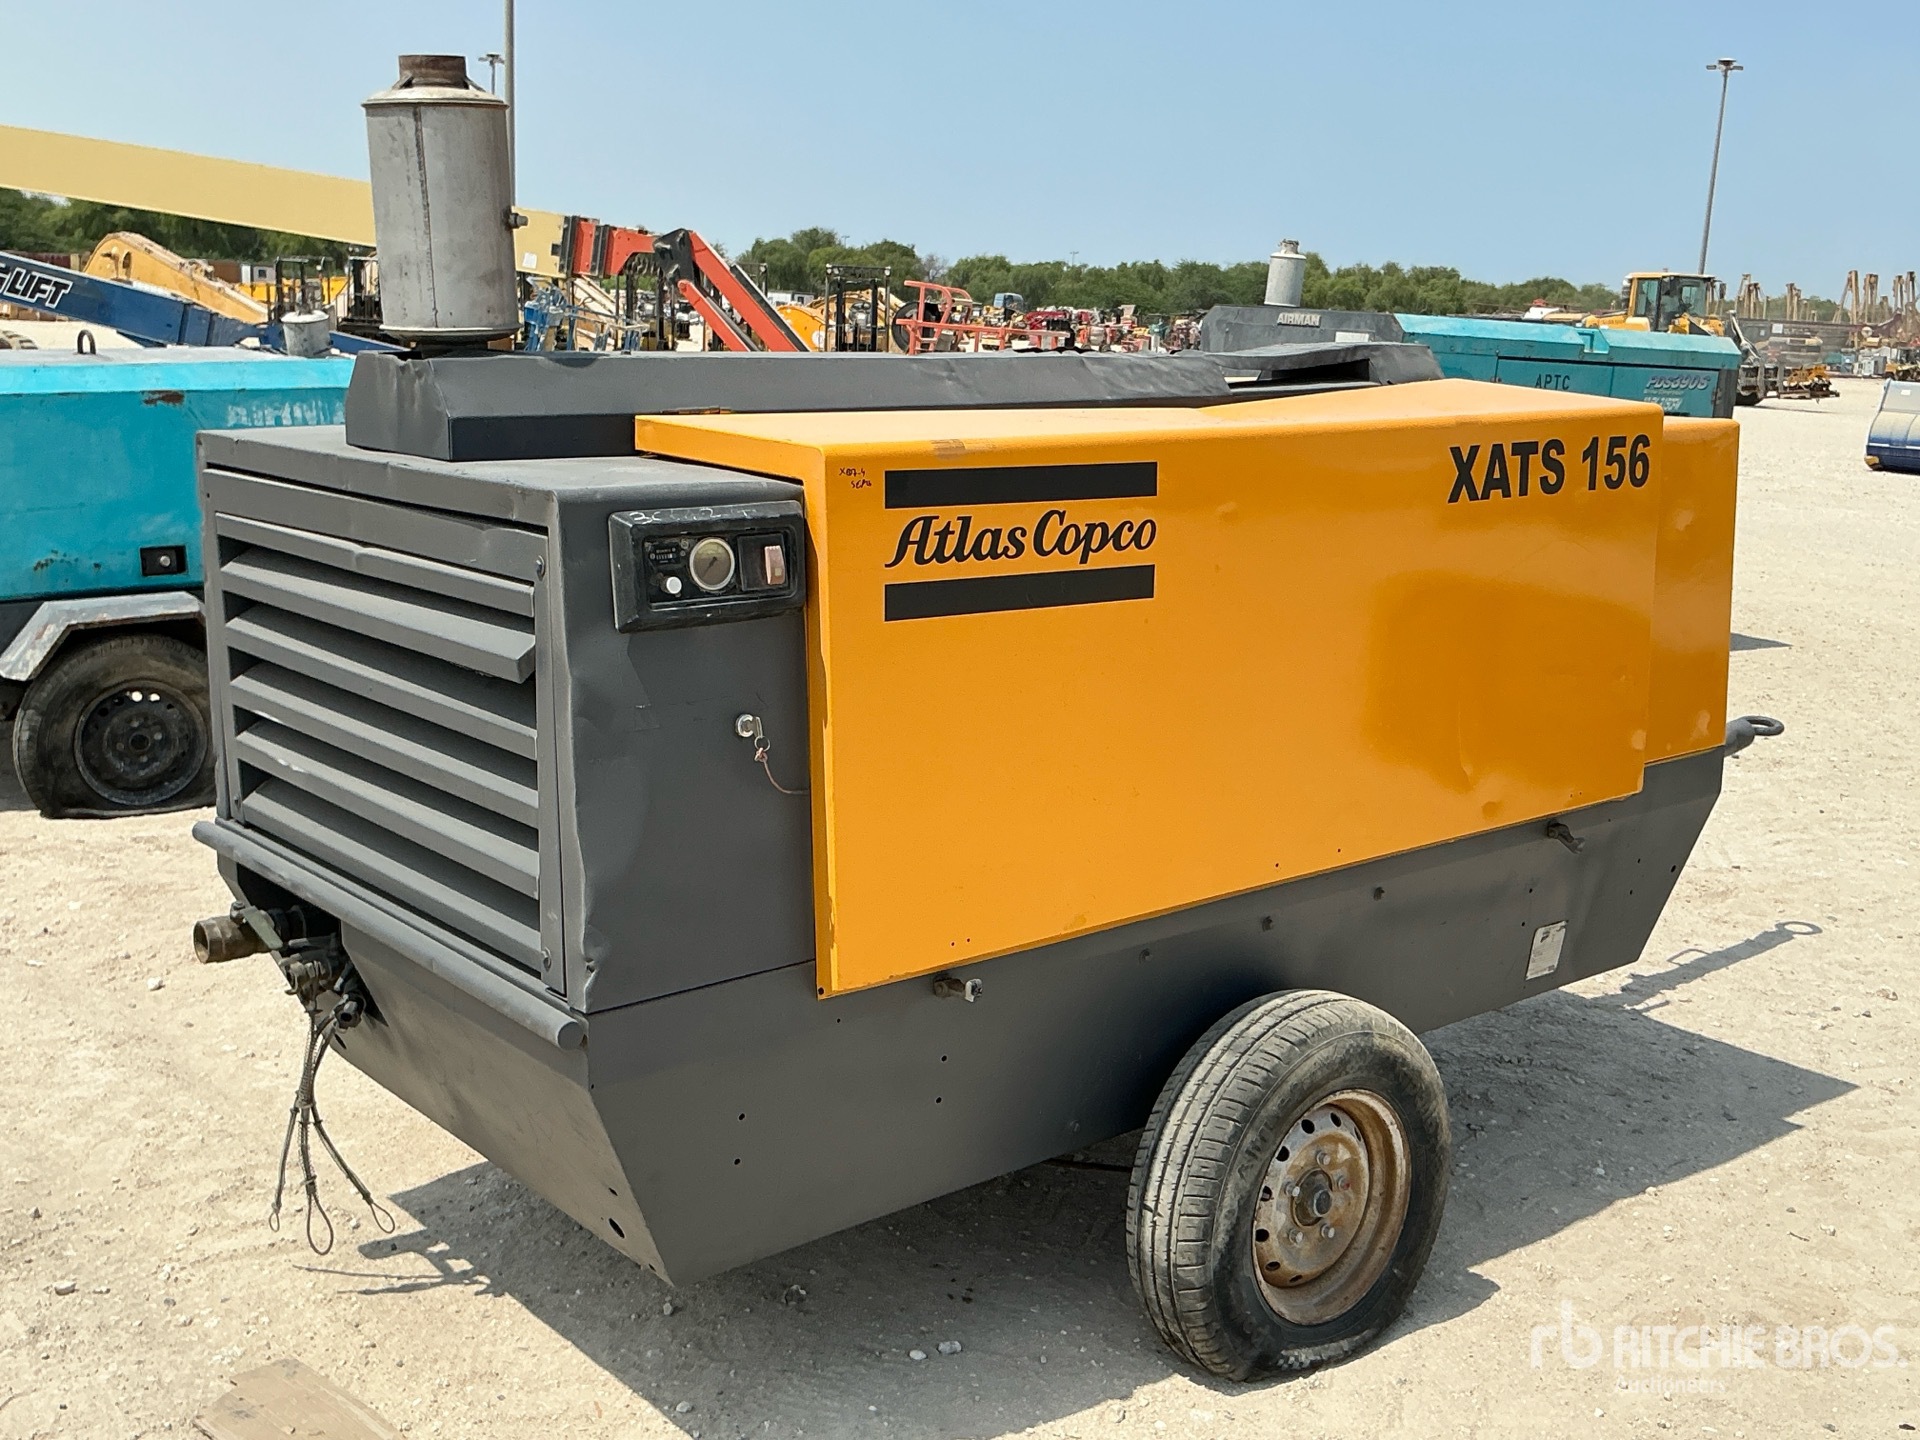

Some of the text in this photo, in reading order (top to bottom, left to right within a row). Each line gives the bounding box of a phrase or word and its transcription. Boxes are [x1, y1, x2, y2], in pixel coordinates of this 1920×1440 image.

[1277, 312, 1321, 328] AIRMAN
[1535, 373, 1571, 391] APTC
[1447, 434, 1650, 504] XATS 156
[884, 509, 1157, 568] Atlas Copco
